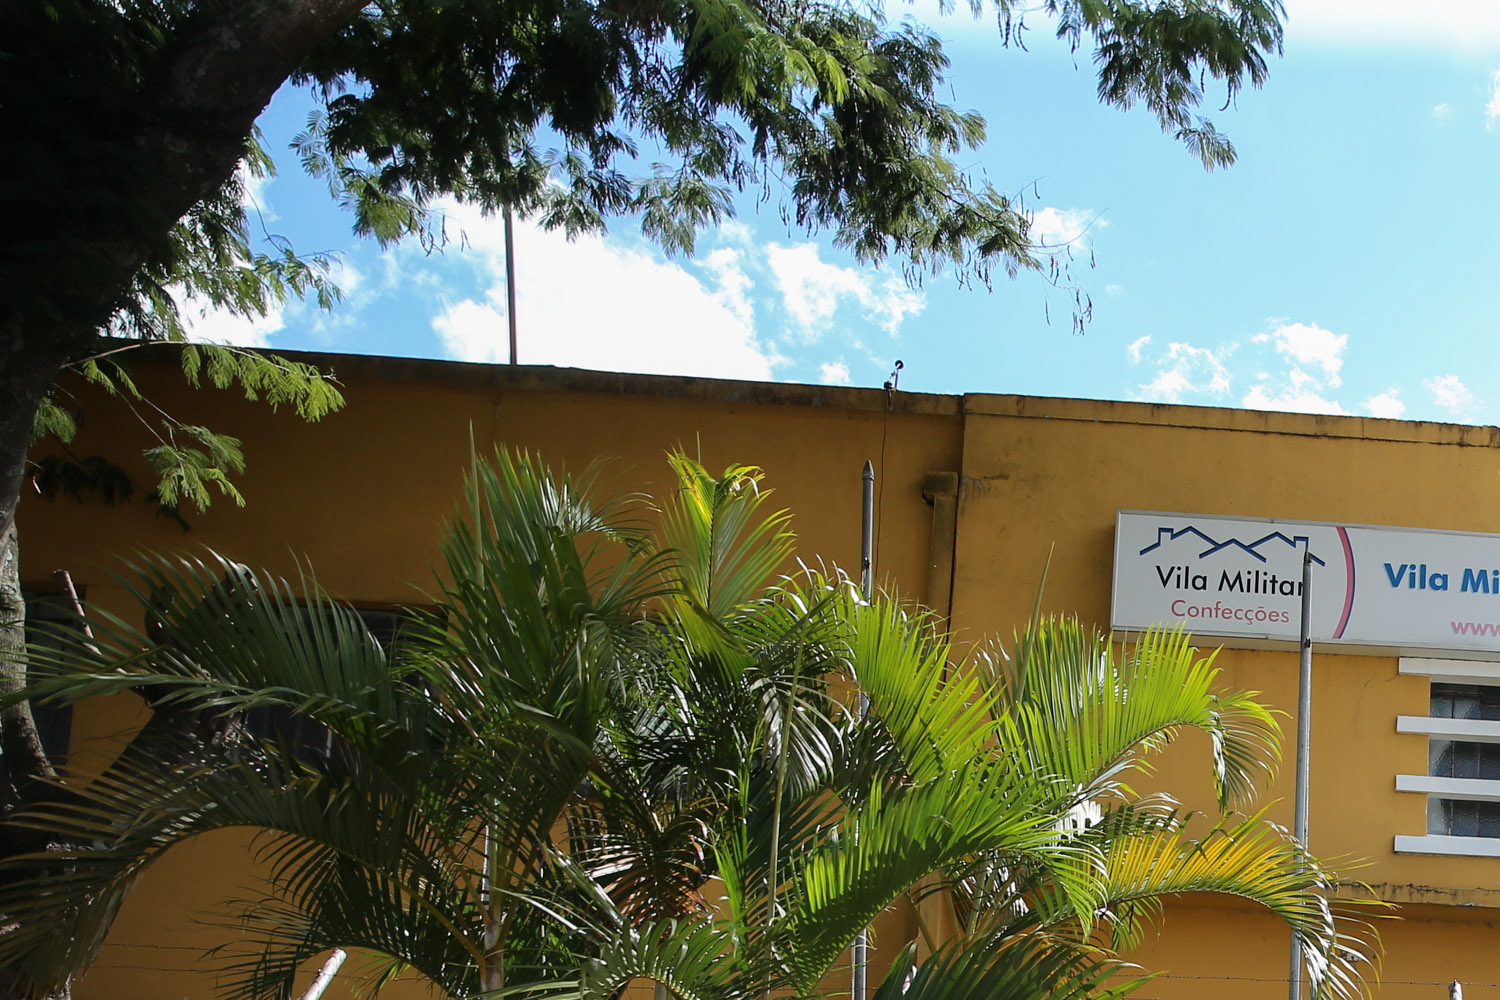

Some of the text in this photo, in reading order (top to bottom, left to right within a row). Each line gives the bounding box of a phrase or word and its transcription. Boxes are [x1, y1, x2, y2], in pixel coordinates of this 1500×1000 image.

[1155, 565, 1303, 597] Vila Militar
[1384, 562, 1449, 592] Vila
[1170, 599, 1290, 626] Confecções
